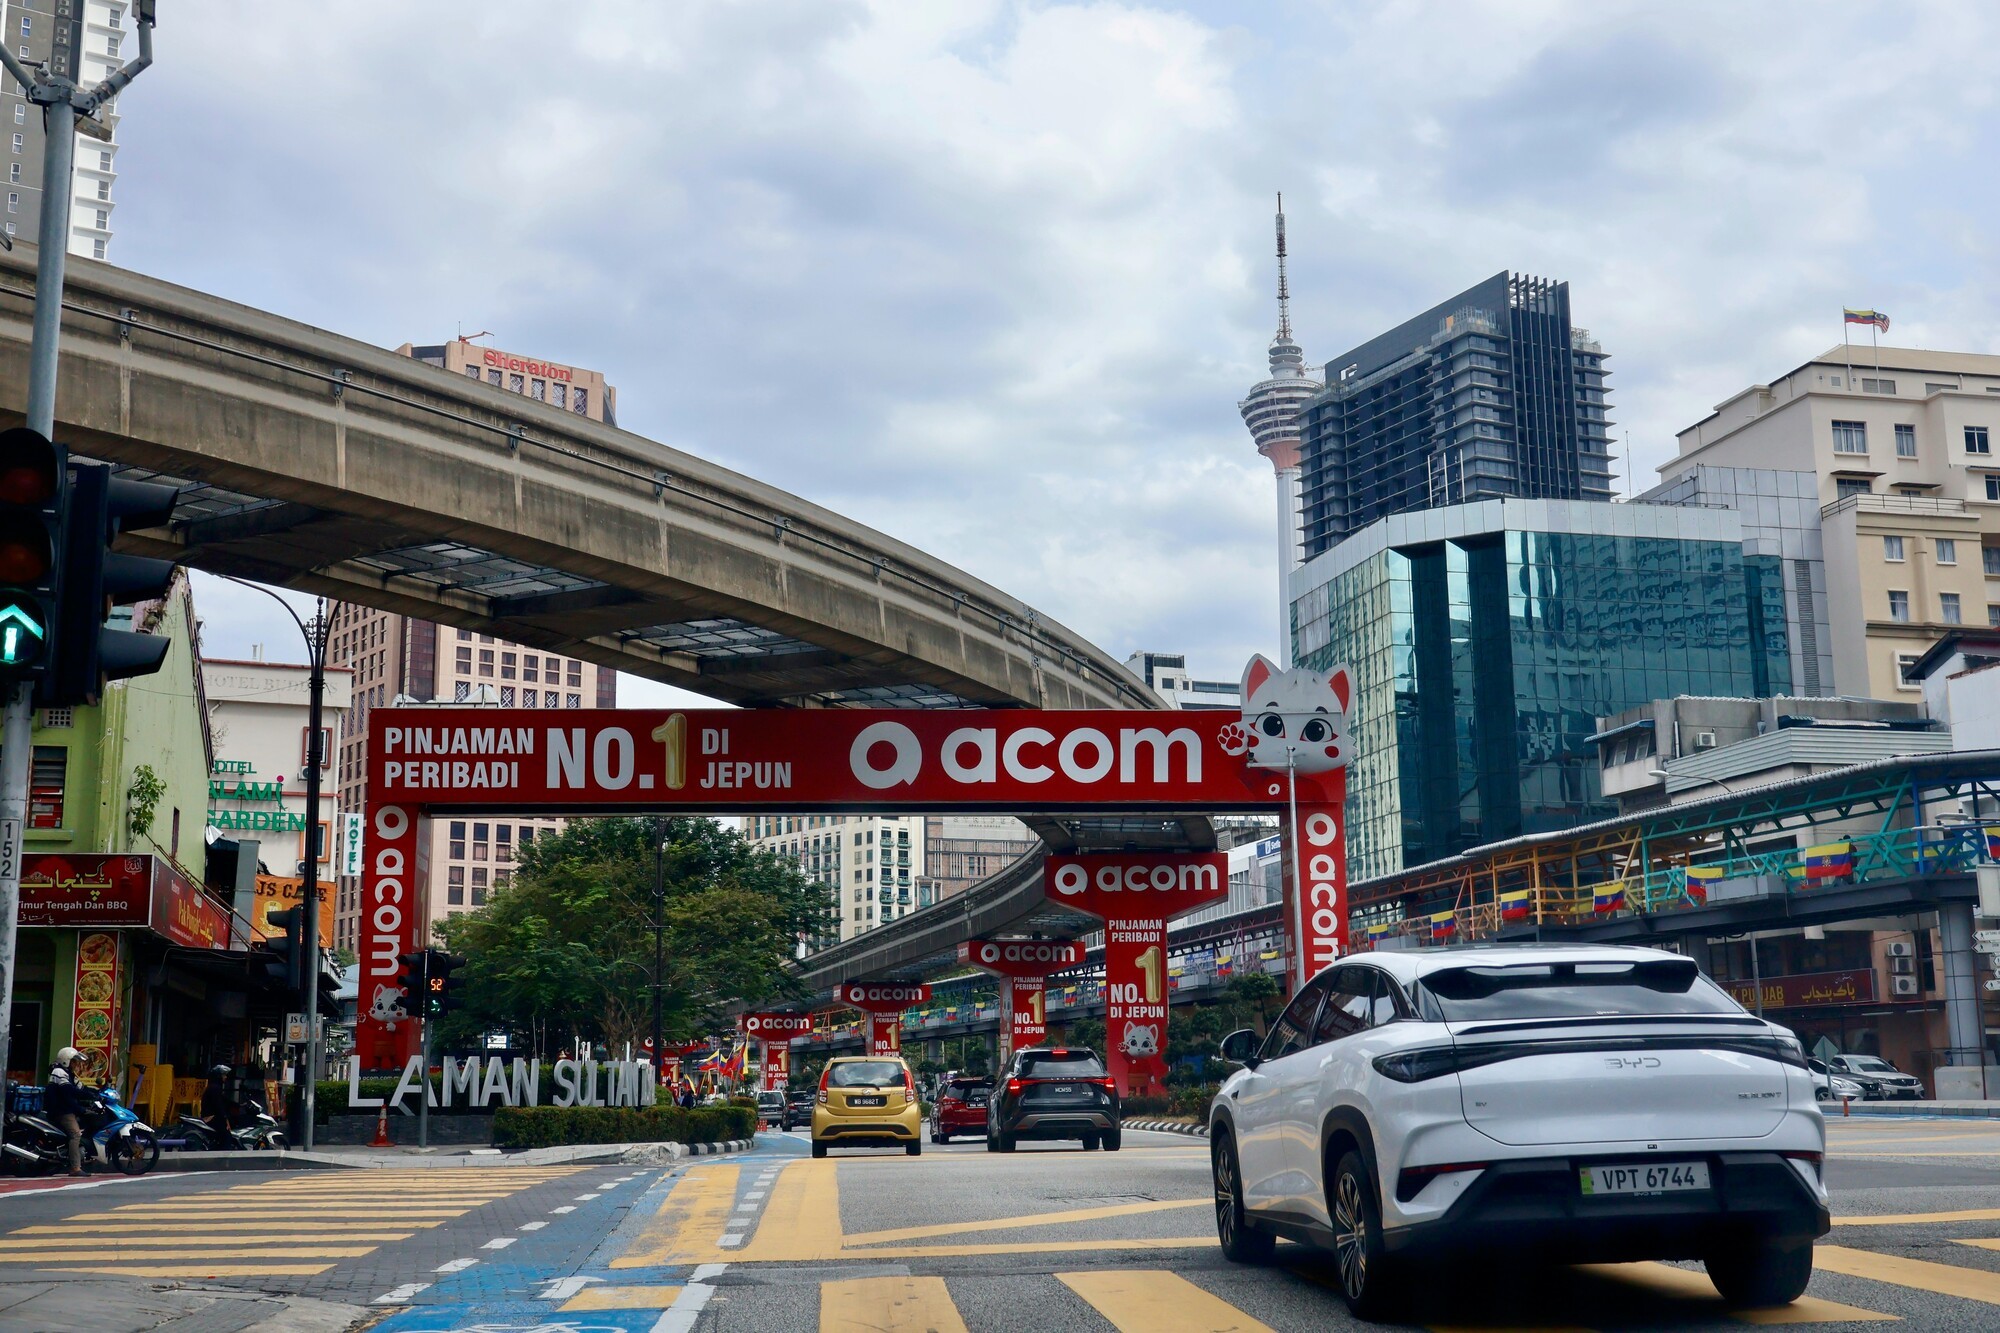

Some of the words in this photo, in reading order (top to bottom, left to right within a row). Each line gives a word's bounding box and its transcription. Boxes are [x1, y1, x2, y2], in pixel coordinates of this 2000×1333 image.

[484, 350, 571, 382] Sheraton
[385, 727, 534, 754] PINJAMAN
[702, 729, 728, 754] DI
[941, 727, 1202, 783] acom
[212, 761, 257, 774] OTEL
[385, 762, 518, 788] PERIBADI
[700, 762, 791, 789] JEPUN
[1, 822, 12, 877] 152
[348, 817, 359, 873] HOTEL
[1096, 864, 1218, 891] acom
[256, 881, 276, 897] JS
[282, 883, 327, 902] CAE
[46, 901, 82, 912] Tengah
[85, 901, 104, 909] Dan
[107, 901, 128, 911] BBQ
[371, 848, 404, 976] acom
[1109, 920, 1162, 930] PINJAMAN
[1112, 932, 1160, 942] PERIBADI
[1005, 945, 1075, 962] acom
[431, 979, 443, 990] 52
[868, 988, 922, 1000] acom
[1110, 1007, 1121, 1018] DI
[1126, 1006, 1164, 1018] JEPUN
[762, 1018, 809, 1029] acom
[1604, 1057, 1661, 1069] BYD
[348, 1054, 539, 1108] LAMAN
[1602, 1170, 1639, 1190] VPT
[1646, 1166, 1695, 1188] 6744
